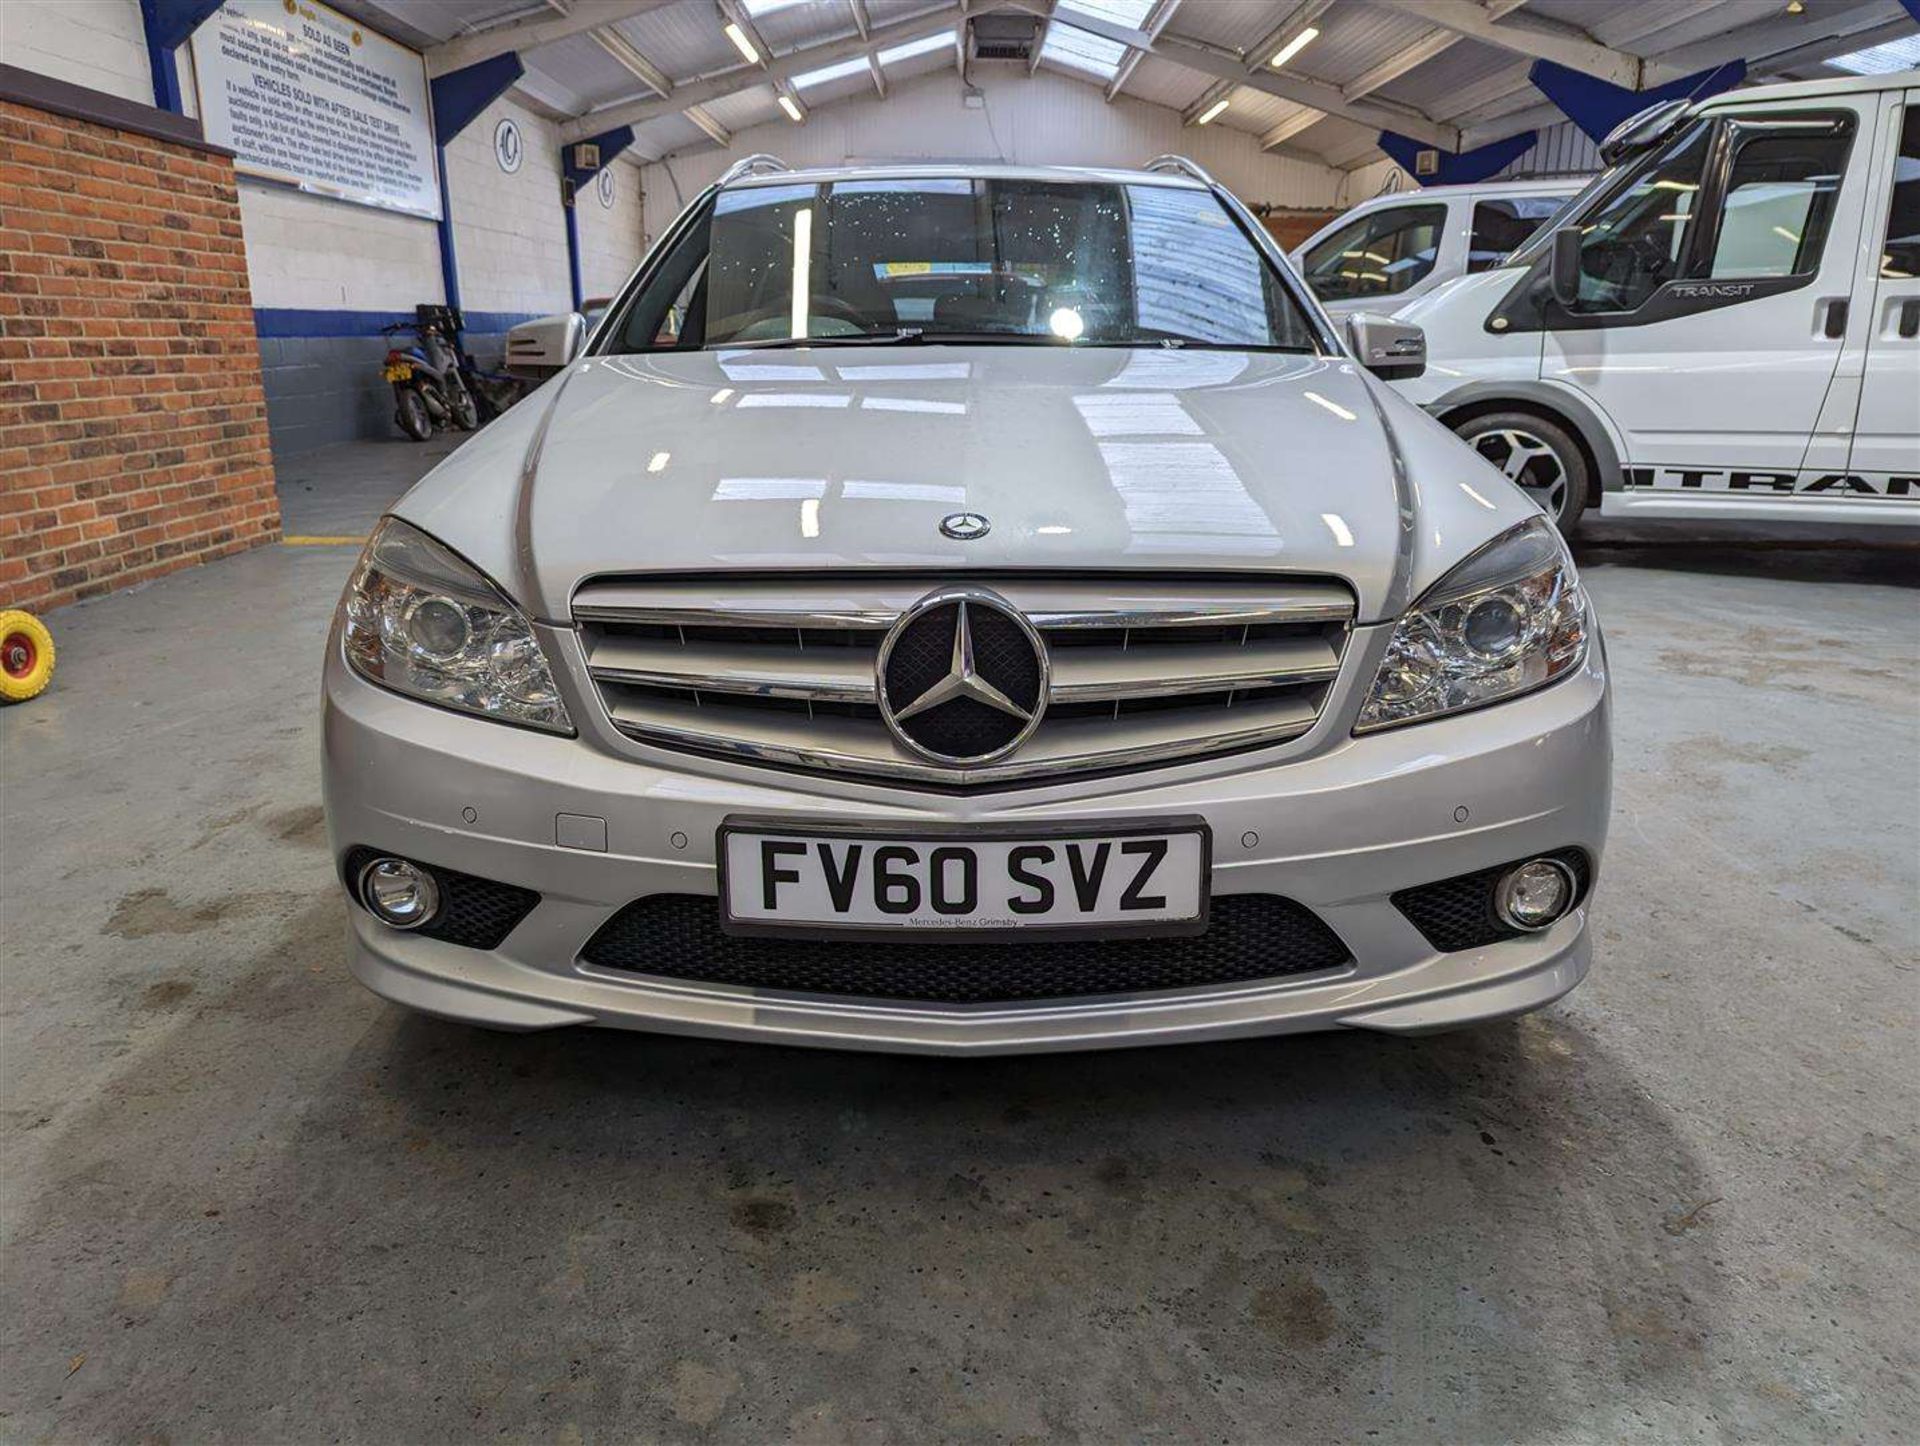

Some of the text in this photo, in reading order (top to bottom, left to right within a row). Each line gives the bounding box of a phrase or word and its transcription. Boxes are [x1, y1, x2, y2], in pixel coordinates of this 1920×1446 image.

[302, 24, 322, 42] SOLD
[322, 33, 332, 47] AS
[333, 38, 350, 55] SEEN
[252, 73, 292, 98] VEHICLES
[292, 88, 313, 105] SOLD
[313, 95, 330, 111] WITH
[330, 101, 351, 118] AFTER
[352, 109, 368, 124] SALE
[368, 115, 383, 129] TEST
[1672, 285, 1755, 297] TRANSIT
[761, 839, 1169, 915] FV60 SVZ
[910, 918, 1018, 929] Mercedes-Benz Grimsby
